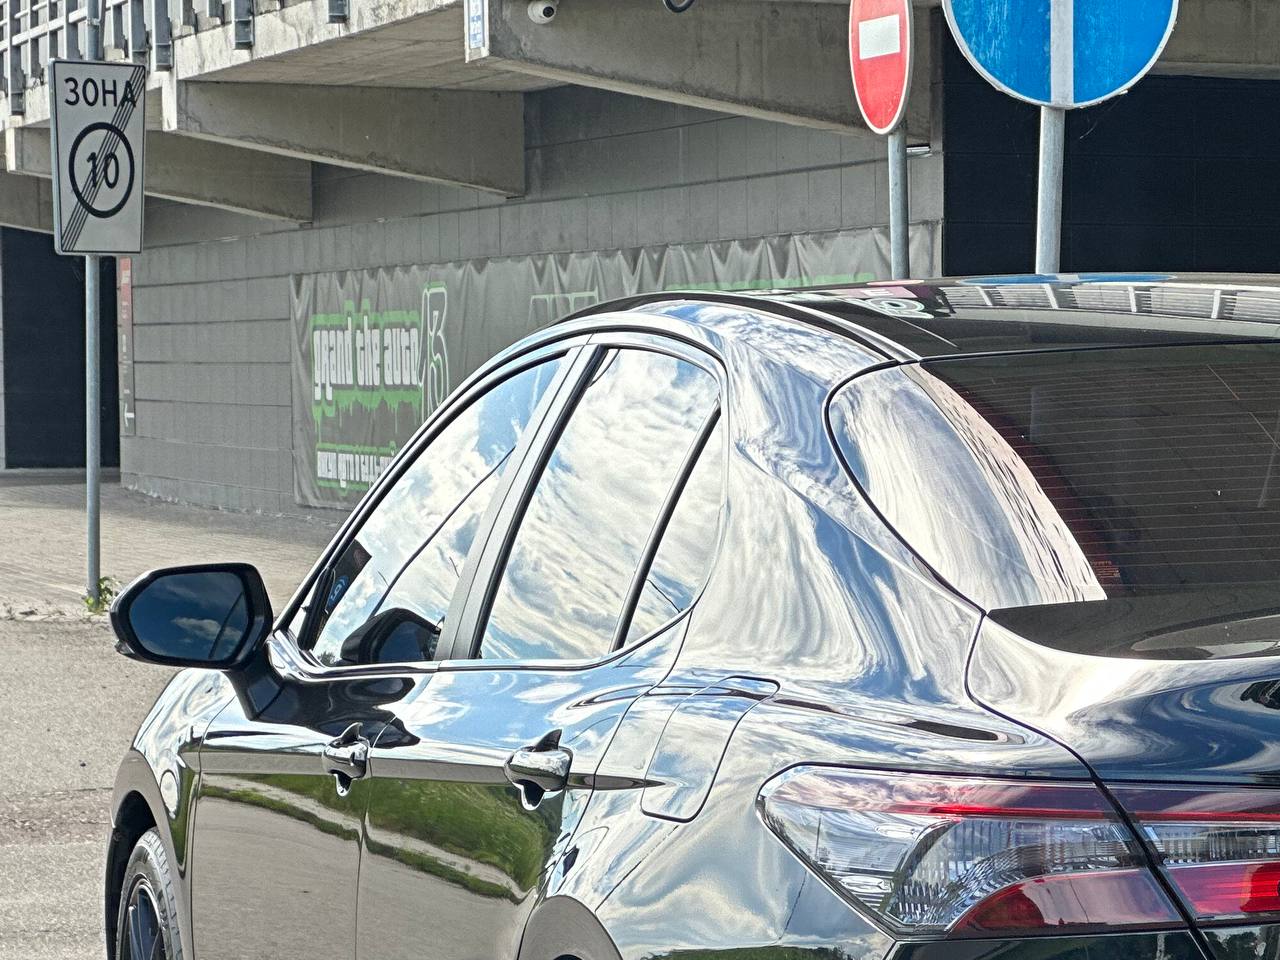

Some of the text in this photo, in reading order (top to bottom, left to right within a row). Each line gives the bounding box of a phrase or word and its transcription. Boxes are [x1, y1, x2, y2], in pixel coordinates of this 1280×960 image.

[64, 77, 136, 107] ЗОНА
[86, 151, 119, 189] 10
[356, 315, 380, 386] the
[384, 328, 419, 386] auto
